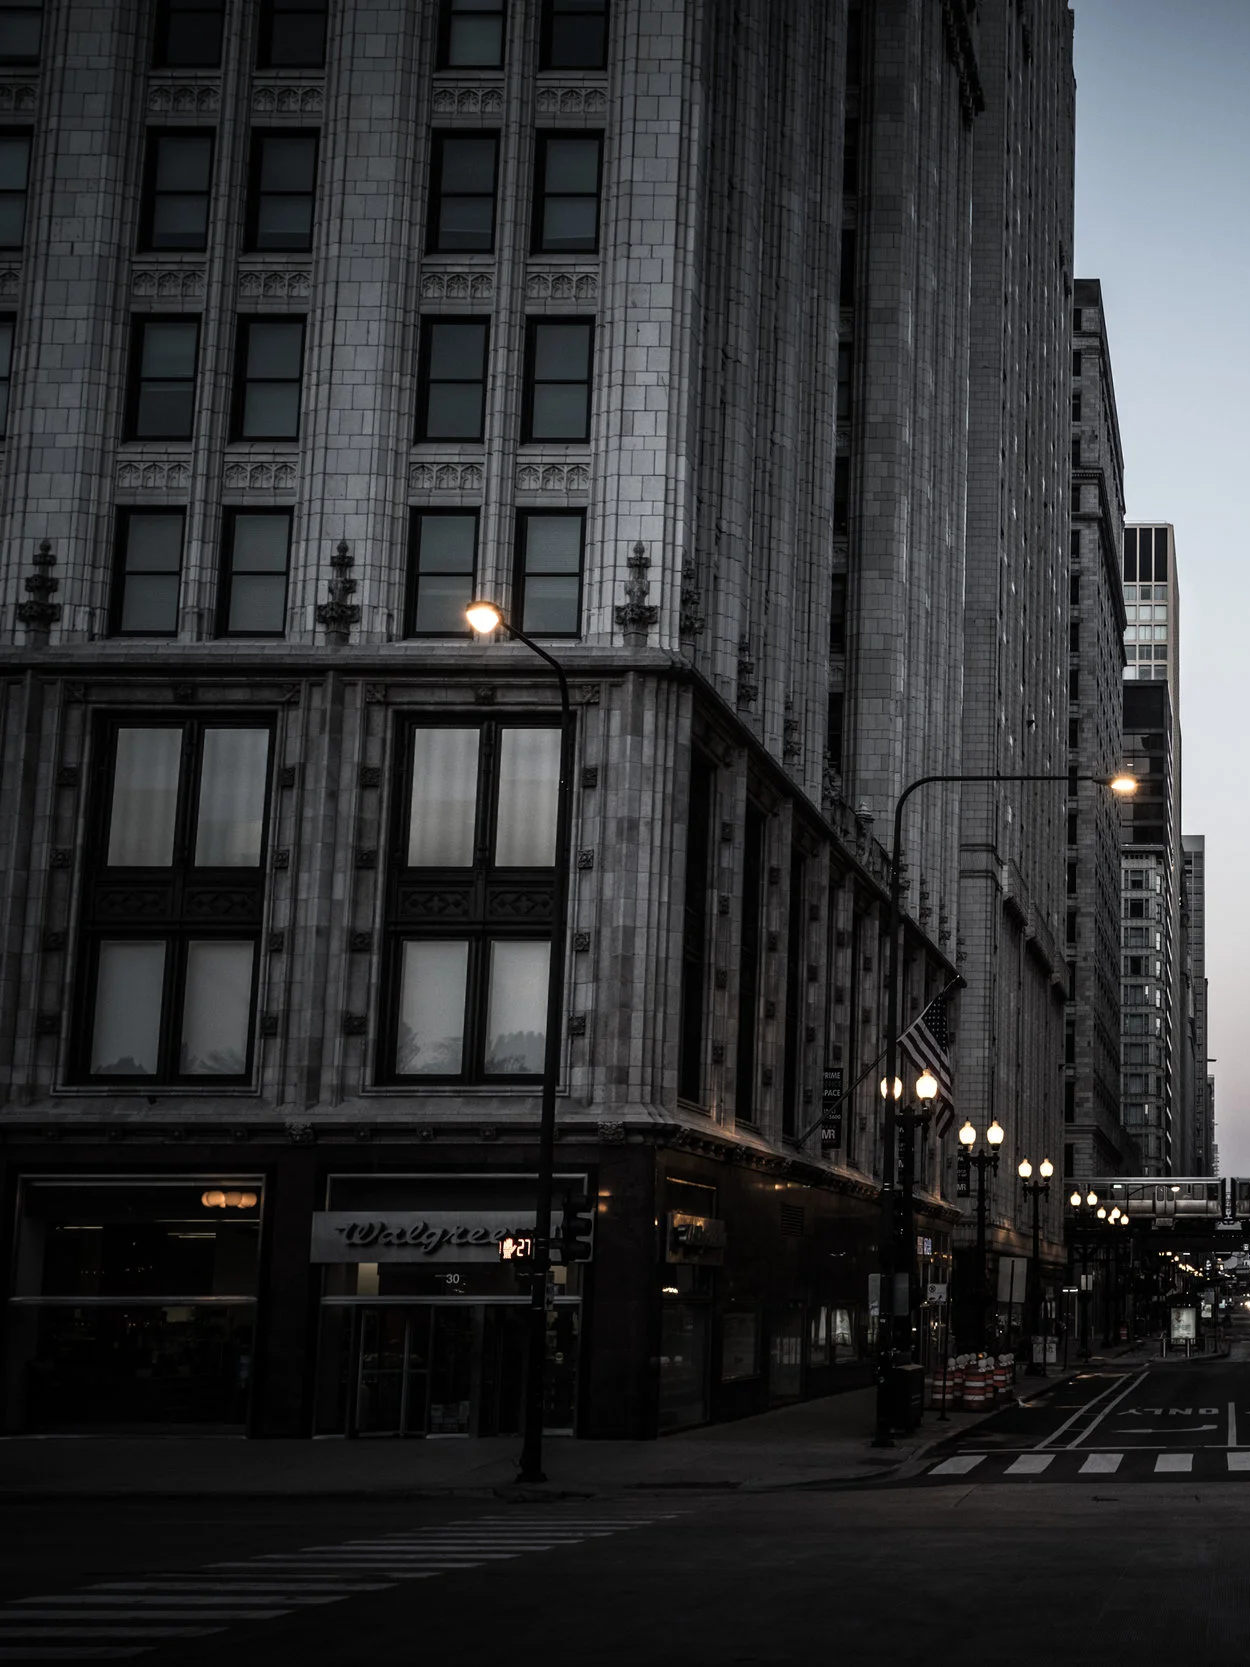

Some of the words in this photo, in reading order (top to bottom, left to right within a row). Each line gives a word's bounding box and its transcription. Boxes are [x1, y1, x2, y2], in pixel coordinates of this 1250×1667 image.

[823, 1088, 841, 1097] PACE
[335, 1220, 561, 1255] Walgree
[516, 1238, 531, 1257] 27
[445, 1273, 460, 1284] 30
